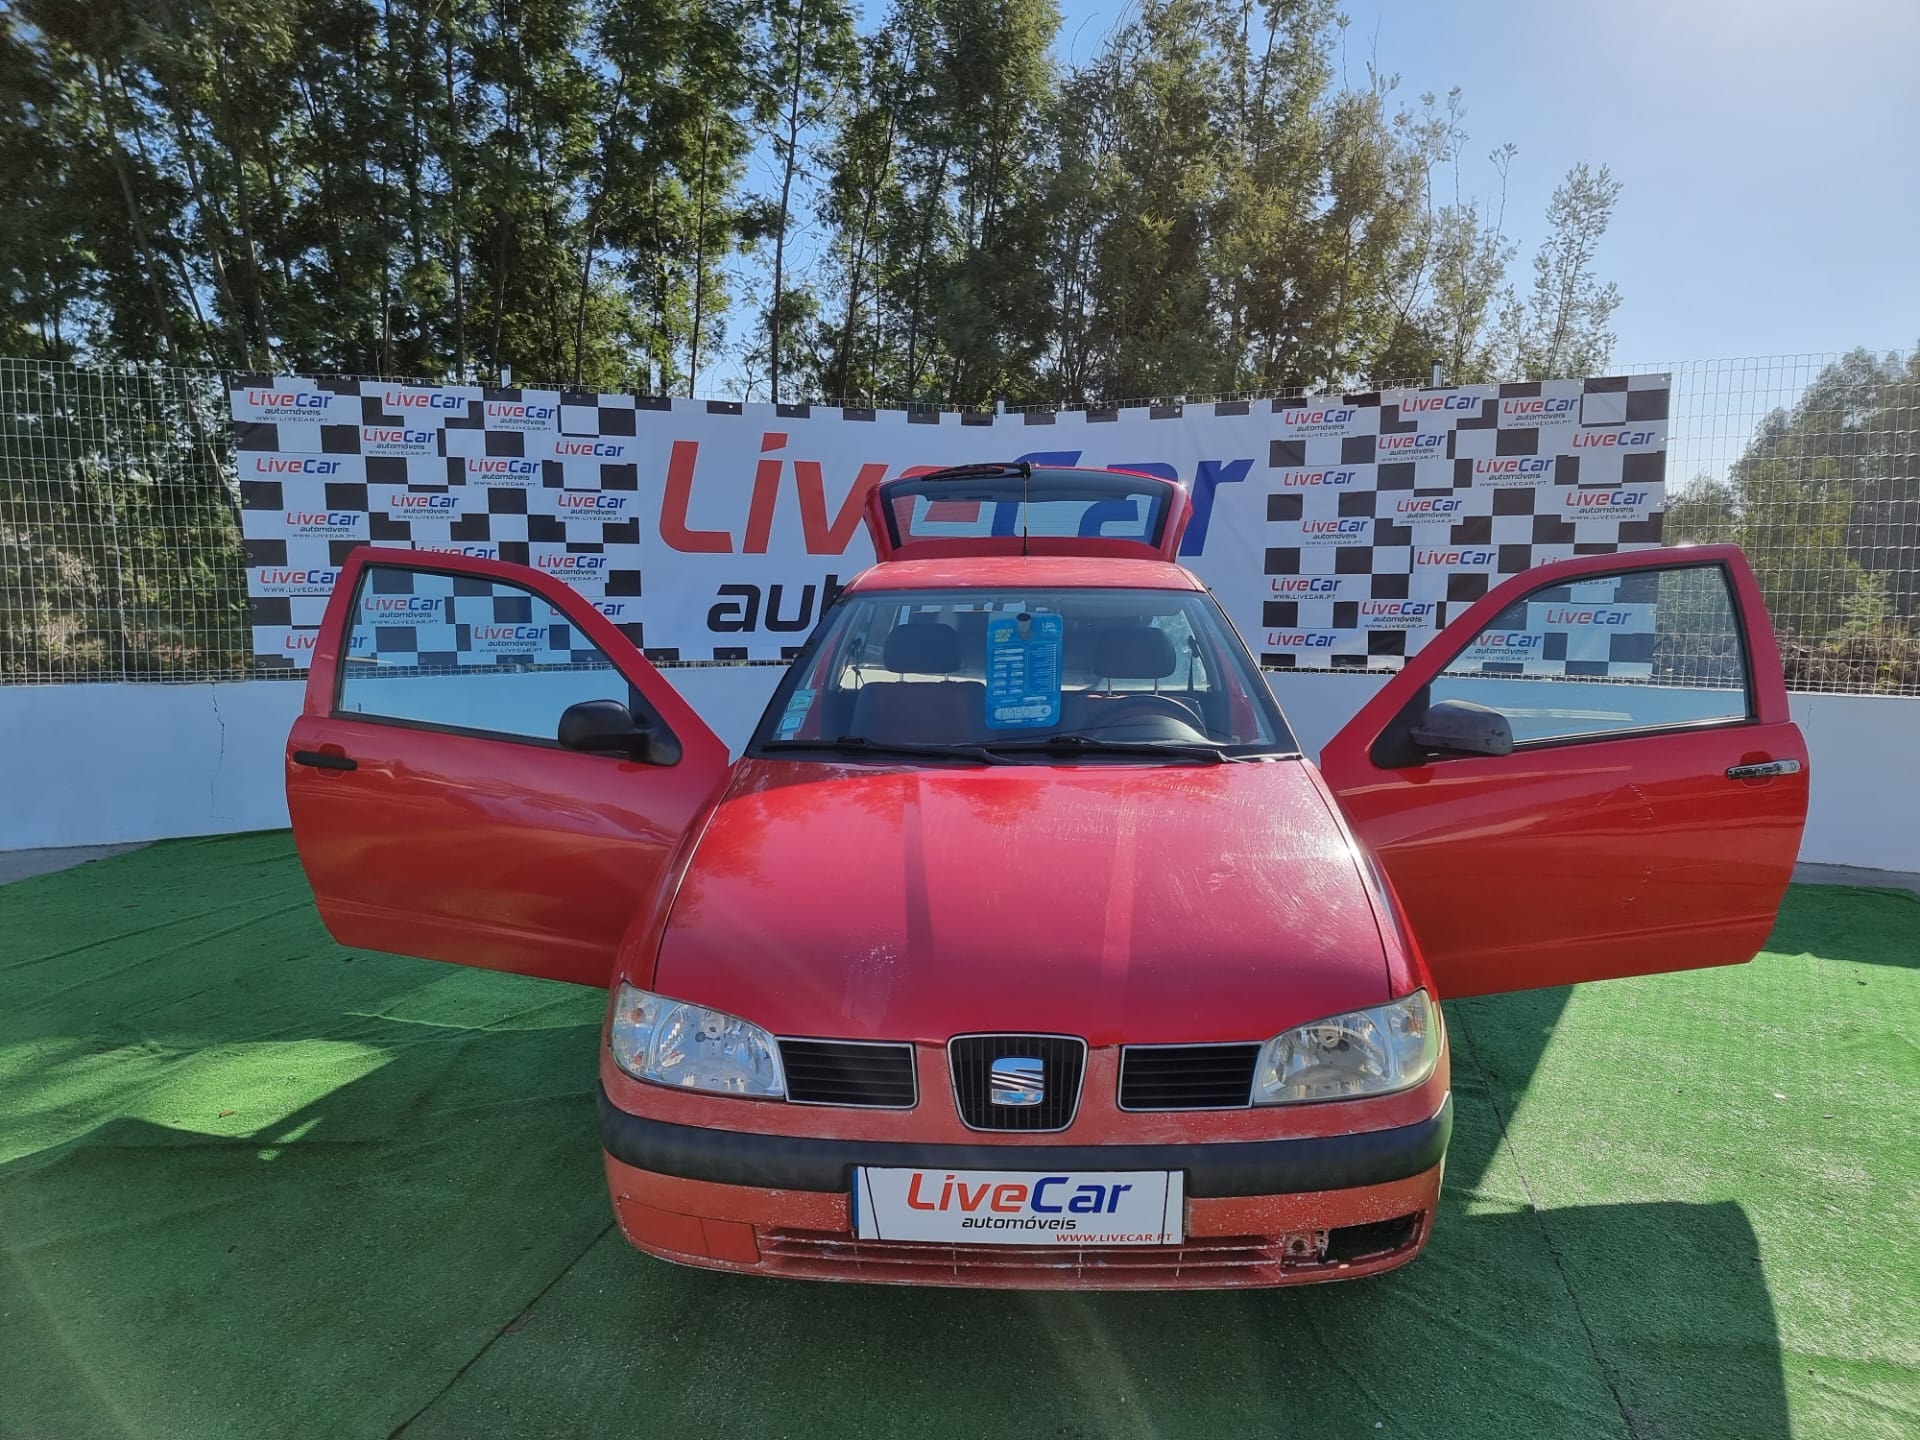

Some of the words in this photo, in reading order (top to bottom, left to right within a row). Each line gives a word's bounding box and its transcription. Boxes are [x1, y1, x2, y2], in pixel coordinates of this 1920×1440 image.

[249, 391, 332, 408] LiveCar
[386, 392, 466, 408] LiveCar
[1402, 396, 1480, 412] LiveCar
[1504, 398, 1578, 414] LiveCar
[488, 403, 556, 419] LiveCar
[1285, 409, 1356, 424] LiveCar
[364, 428, 435, 443] LiveCar
[1378, 434, 1446, 450] LiveCar
[1572, 432, 1656, 448] LiveCar
[556, 441, 624, 456] LiveCar
[256, 457, 340, 474] LiveCar
[469, 458, 540, 474] LiveCar
[1476, 458, 1554, 473] LiveCar
[1284, 471, 1356, 486] LiveCar
[392, 494, 459, 508] LiveCar
[558, 494, 626, 508] LiveCar
[1396, 499, 1462, 512] LiveCar
[1566, 491, 1648, 506] LiveCar
[286, 512, 360, 526] LiveCar
[1302, 520, 1368, 533] LiveCar
[538, 554, 606, 568] LiveCar
[1417, 550, 1496, 565] LiveCar
[1272, 578, 1342, 592] LiveCar
[364, 596, 442, 610] LiveCar
[1362, 601, 1434, 615] LiveCar
[1547, 609, 1632, 624] LiveCar
[474, 626, 546, 640] LiveCar
[1268, 632, 1336, 647] LiveCar
[907, 1173, 1132, 1214] LiveCar
[962, 1216, 1076, 1230] automóveis
[1056, 1232, 1174, 1243] WWW.LIVECAR.PT
